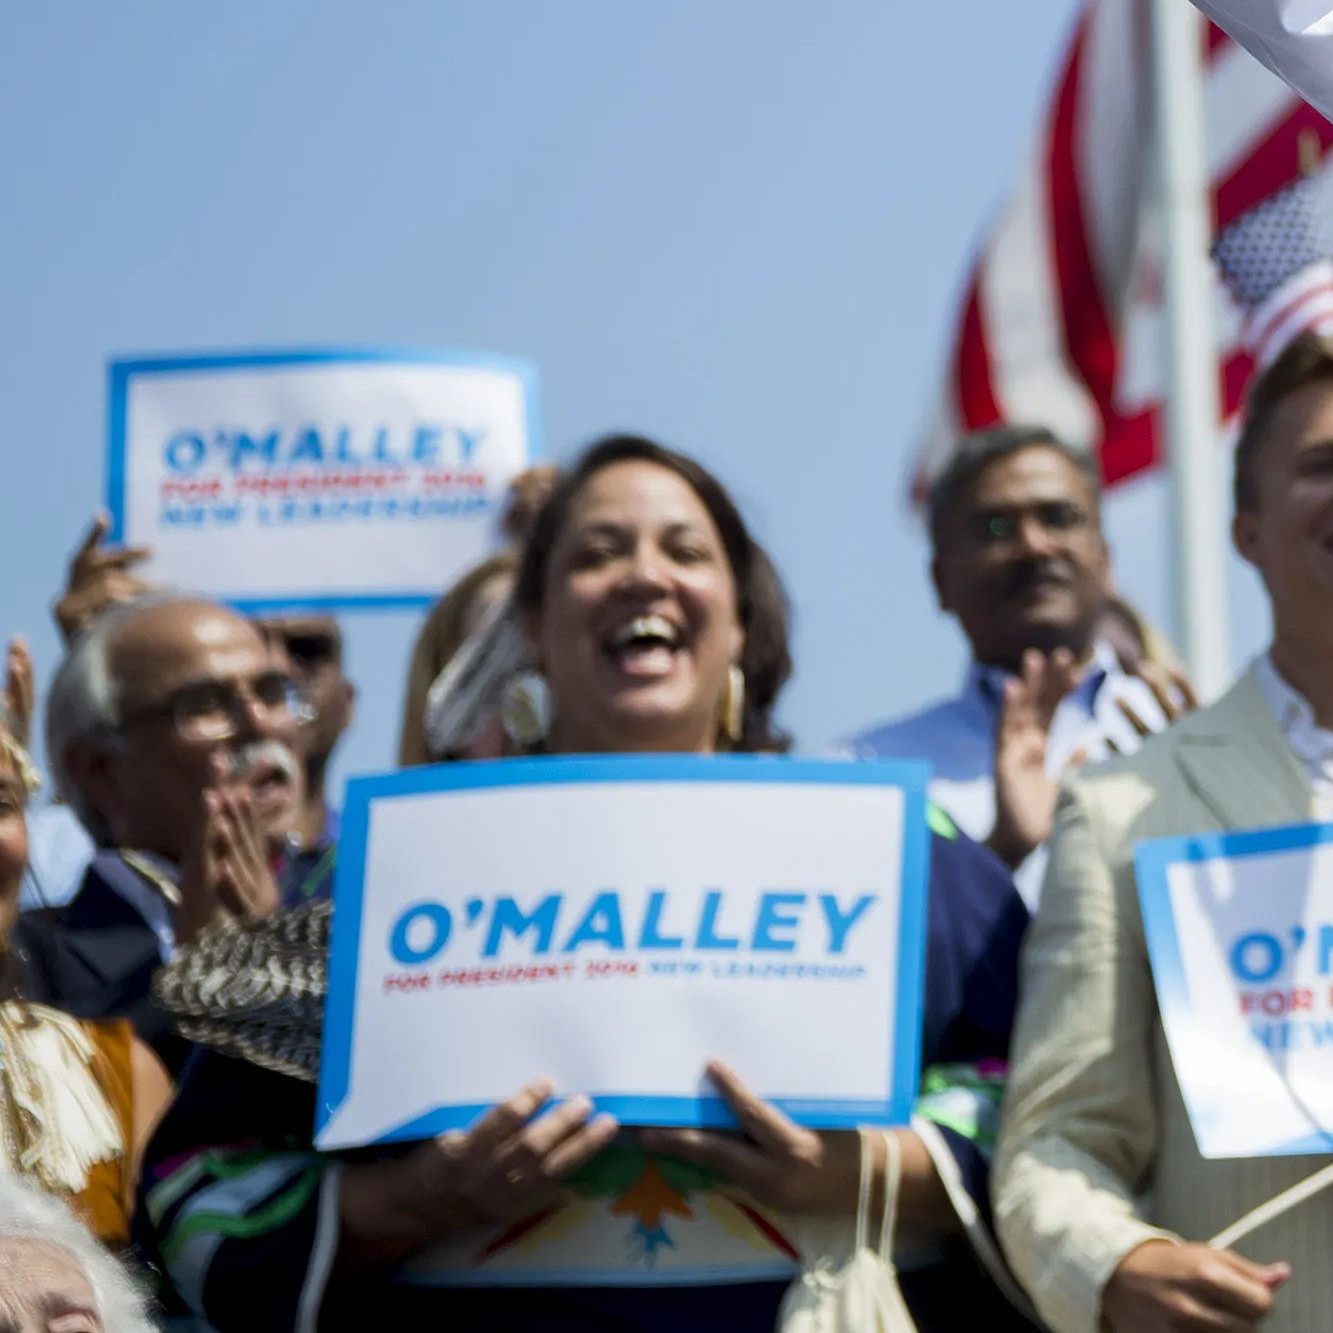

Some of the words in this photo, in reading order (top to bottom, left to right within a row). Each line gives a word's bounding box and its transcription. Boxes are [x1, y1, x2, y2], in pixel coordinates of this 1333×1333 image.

[165, 425, 488, 471] O'MALLEY
[387, 889, 882, 966] O'MALLEY
[1239, 987, 1312, 1019] FOR
